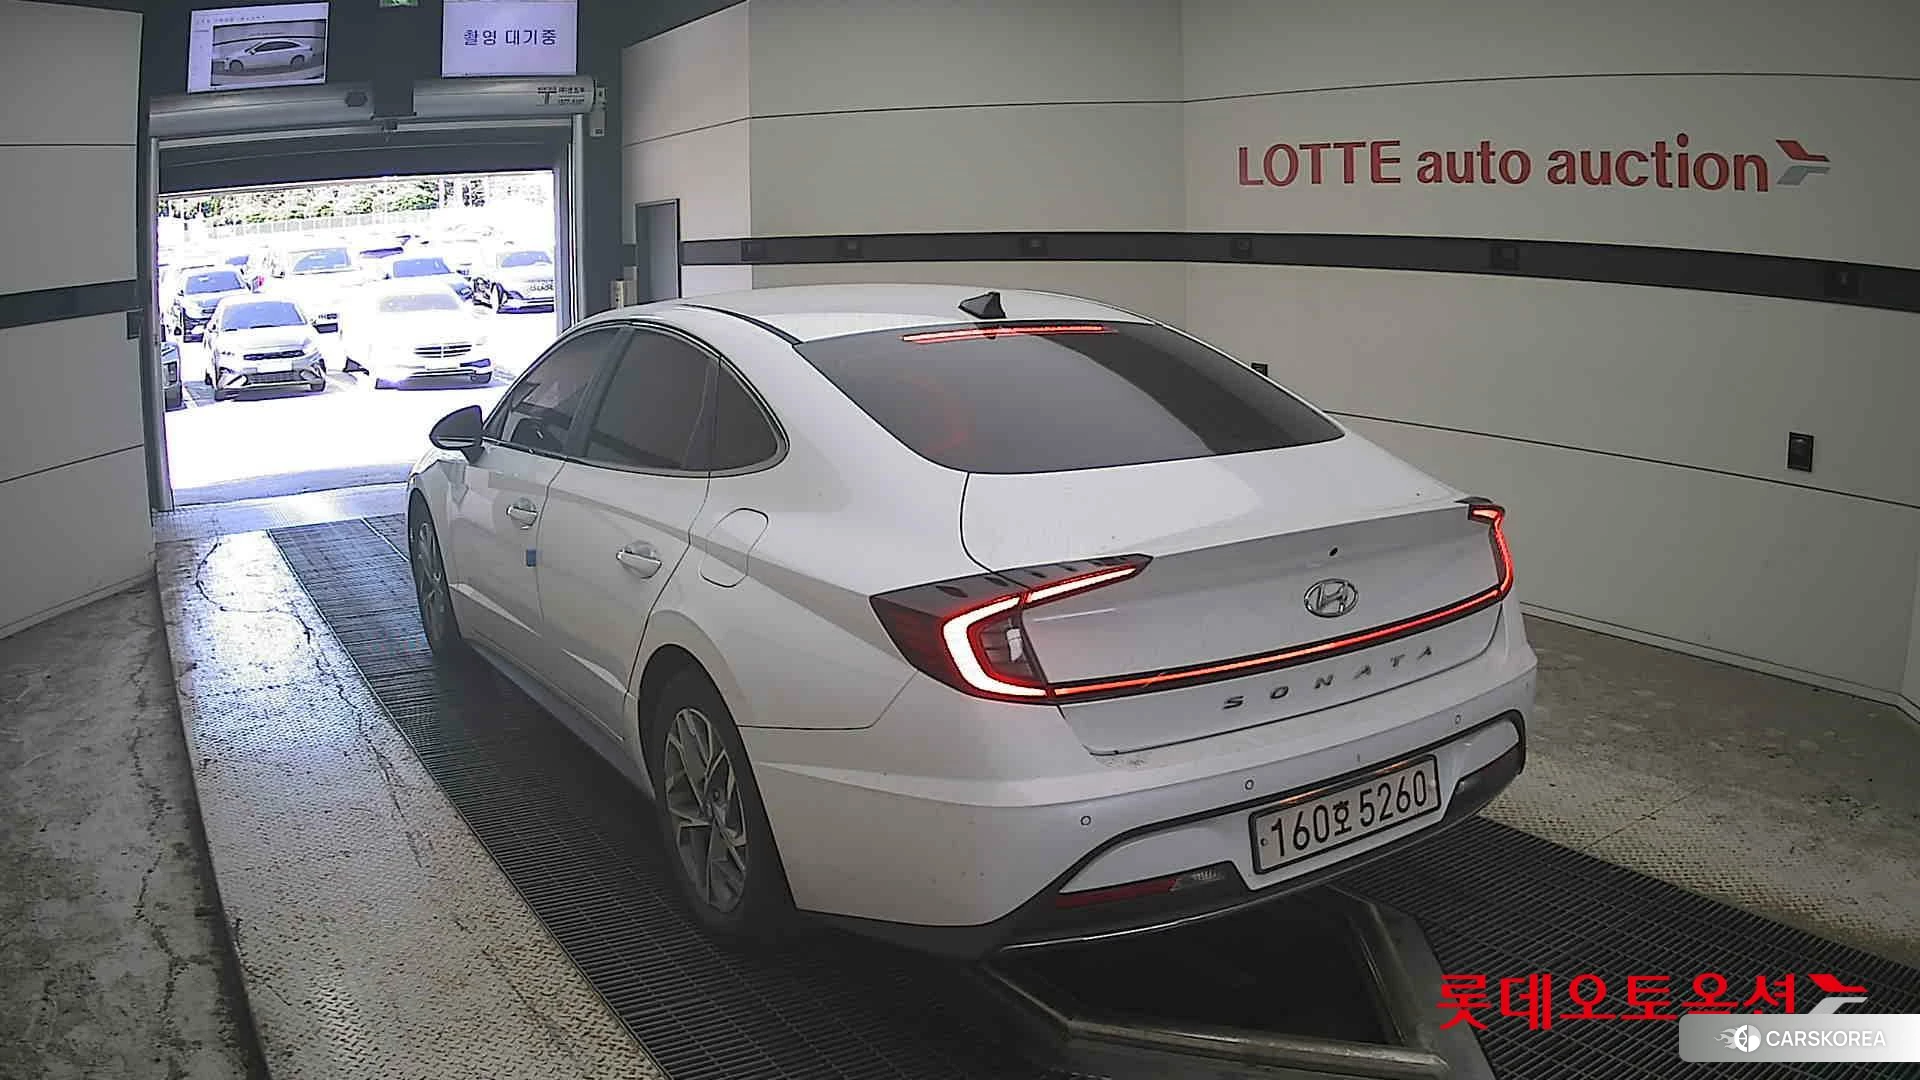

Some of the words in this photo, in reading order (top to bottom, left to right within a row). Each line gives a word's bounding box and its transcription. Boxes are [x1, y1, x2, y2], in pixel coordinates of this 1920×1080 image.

[505, 29, 558, 46] 대기중
[1238, 140, 1401, 187] LOTTE
[1416, 141, 1532, 185] auto
[1548, 132, 1769, 193] auction
[1222, 646, 1433, 710] SONATA
